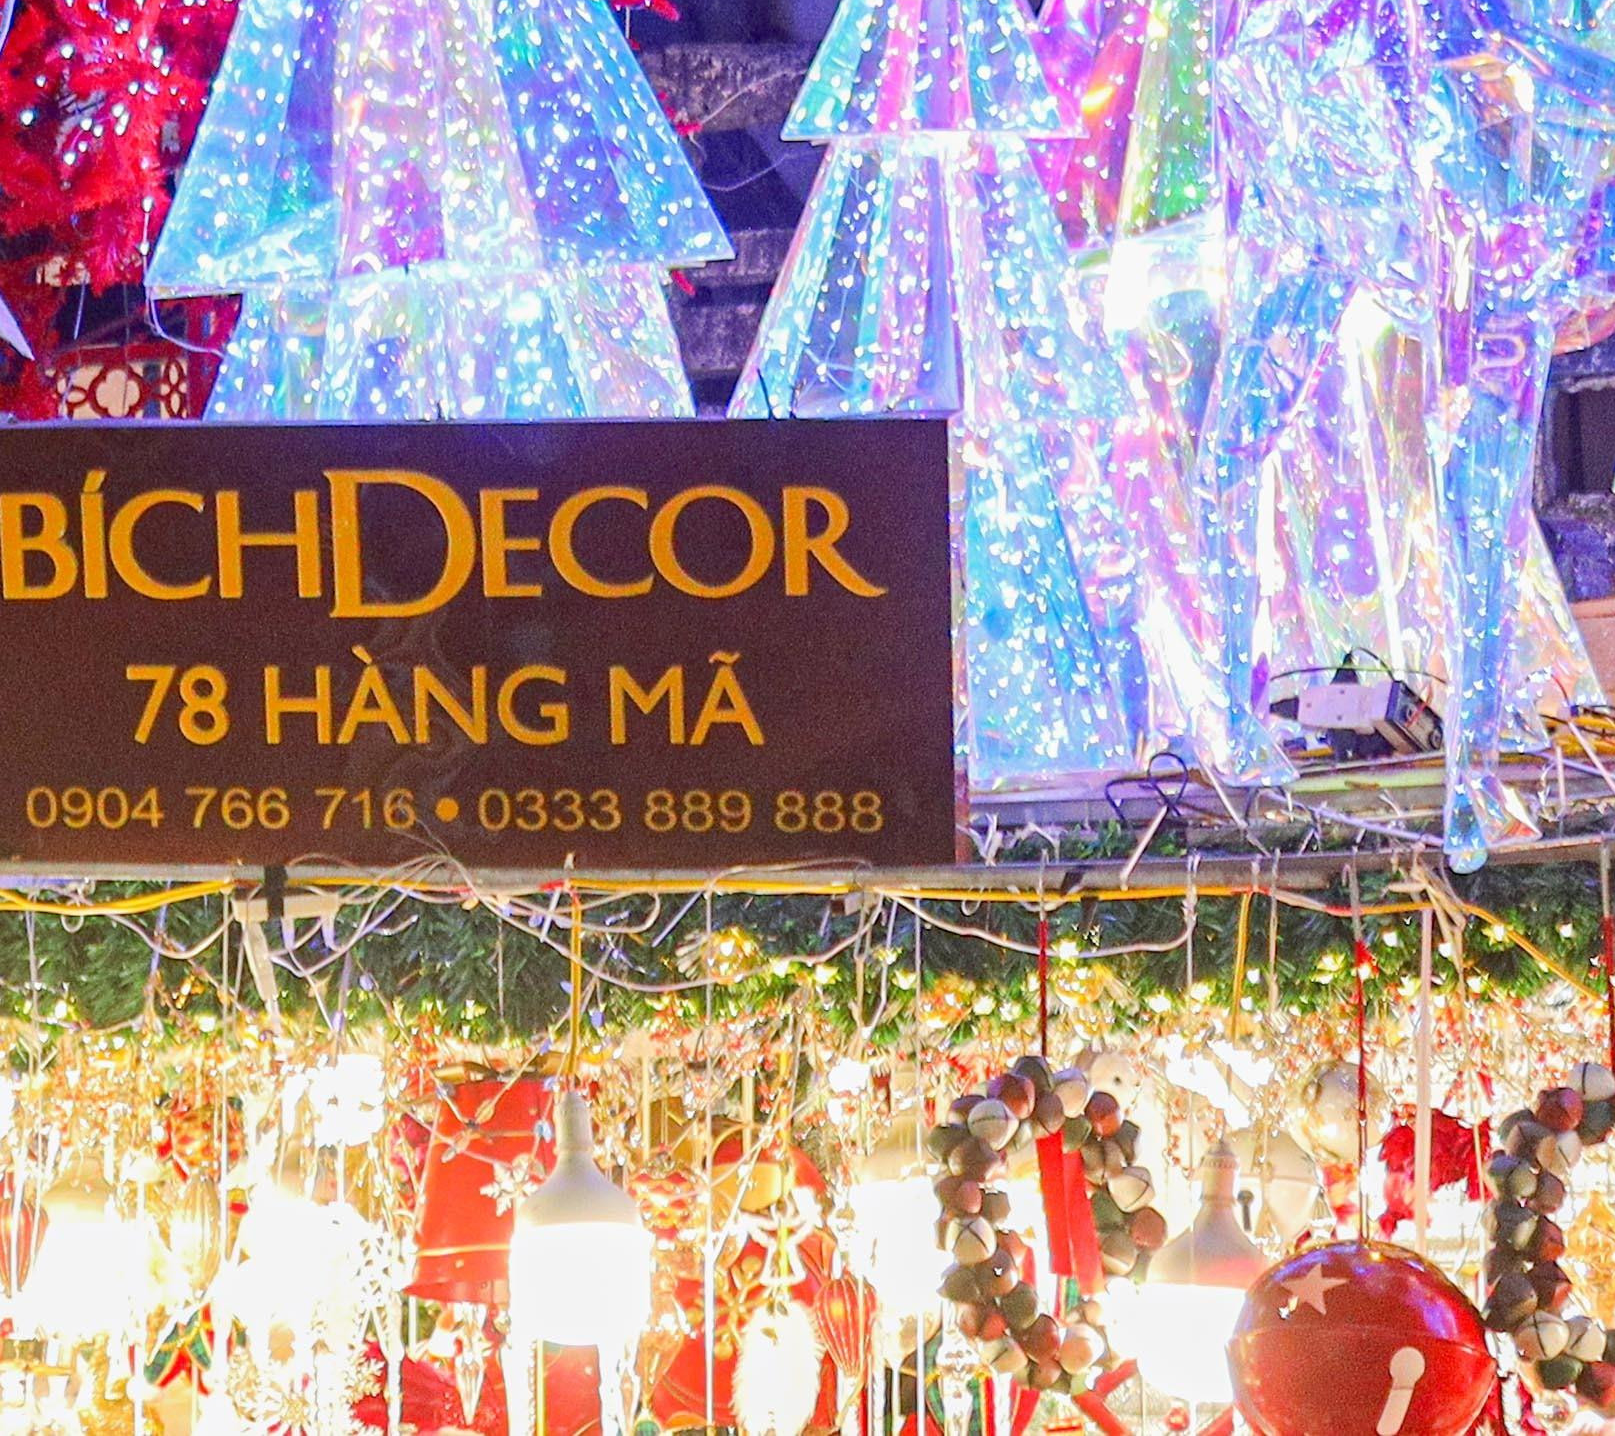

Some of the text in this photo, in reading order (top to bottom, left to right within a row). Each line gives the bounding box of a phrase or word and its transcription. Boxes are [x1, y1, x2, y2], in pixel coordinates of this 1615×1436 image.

[124, 644, 765, 746] 78 HÀNG MÃ
[24, 785, 884, 836] 0904 766 716 0333 889 888
